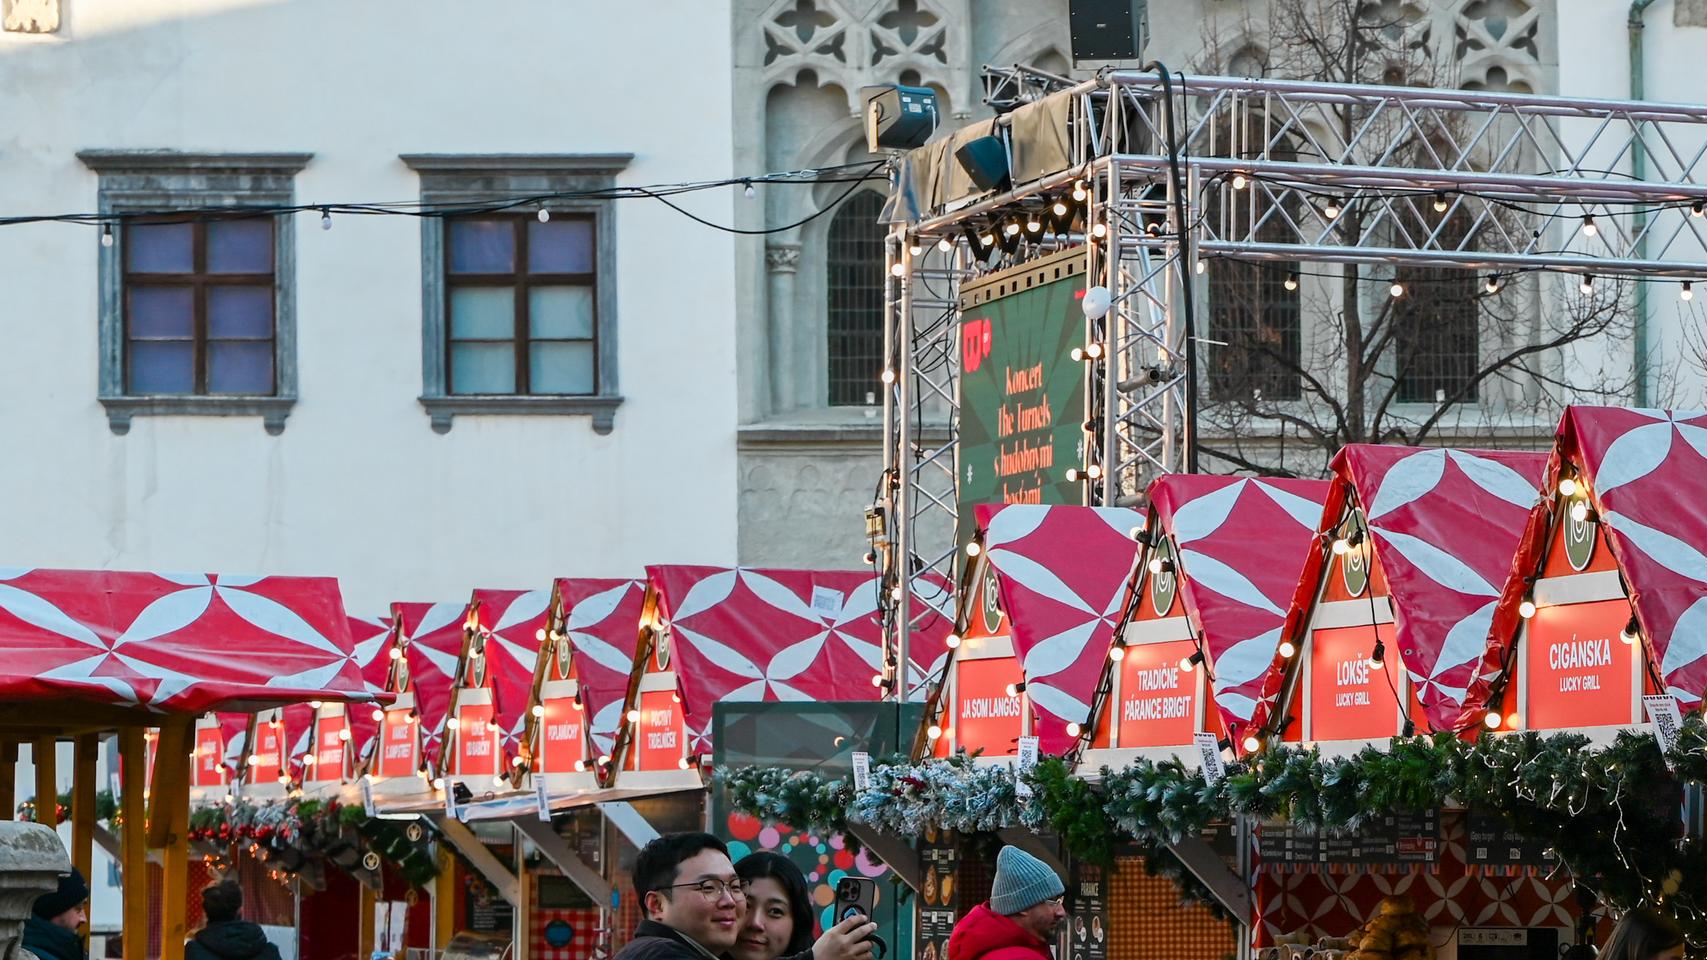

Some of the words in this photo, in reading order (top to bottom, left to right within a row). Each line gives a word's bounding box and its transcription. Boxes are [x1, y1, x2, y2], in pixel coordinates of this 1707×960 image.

[1005, 361, 1043, 395] Koncert
[997, 403, 1014, 437] The
[1549, 634, 1611, 670] CIGÁNSKA
[1137, 662, 1179, 691] TRADIČNÉ
[1336, 657, 1370, 686] LOKŠE
[1559, 676, 1581, 692] LUCKY
[1582, 674, 1600, 690] GRILL
[962, 700, 971, 719] JA
[971, 699, 990, 718] SOM
[991, 696, 1020, 718] LANGOŠ
[1124, 695, 1162, 721] PÁRANCE
[1162, 696, 1191, 719] BRIGIT
[1336, 693, 1353, 707] LUCKY
[1354, 692, 1370, 706] GRILL
